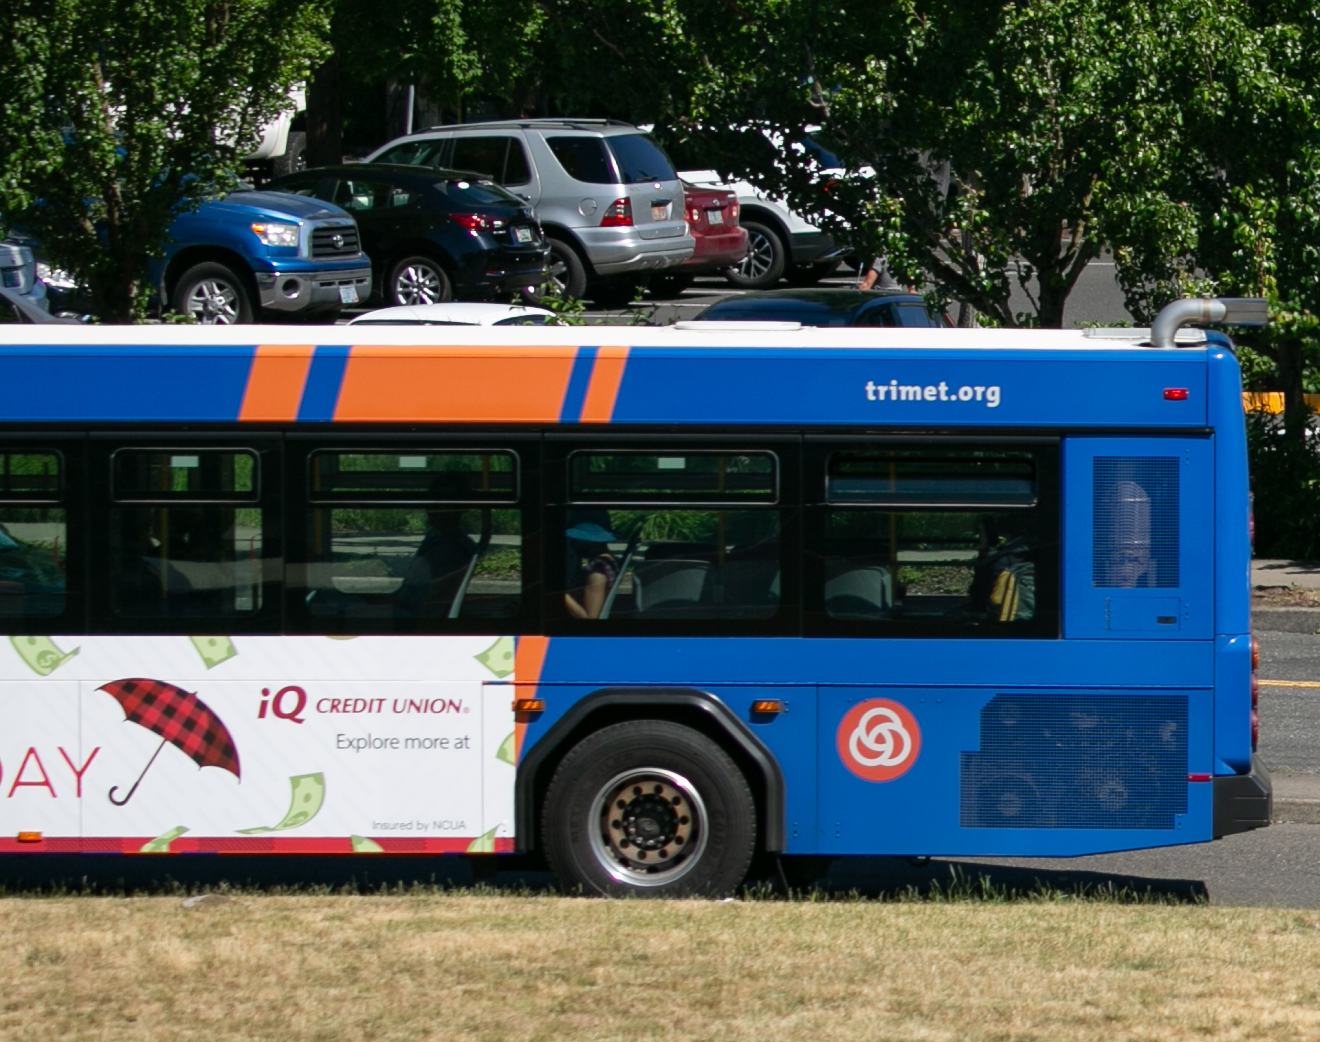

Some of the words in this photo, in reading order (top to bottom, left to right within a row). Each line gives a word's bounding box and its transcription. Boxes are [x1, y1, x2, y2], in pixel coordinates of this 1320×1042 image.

[865, 379, 1001, 408] trimet.org
[257, 685, 307, 724] iQ
[315, 697, 387, 714] CREDIT
[336, 733, 400, 753] Explore
[404, 737, 450, 750] more
[453, 735, 471, 750] at
[0, 746, 101, 798] AY
[372, 820, 414, 831] Insured
[416, 820, 430, 832] by
[432, 820, 467, 831] NCUA
